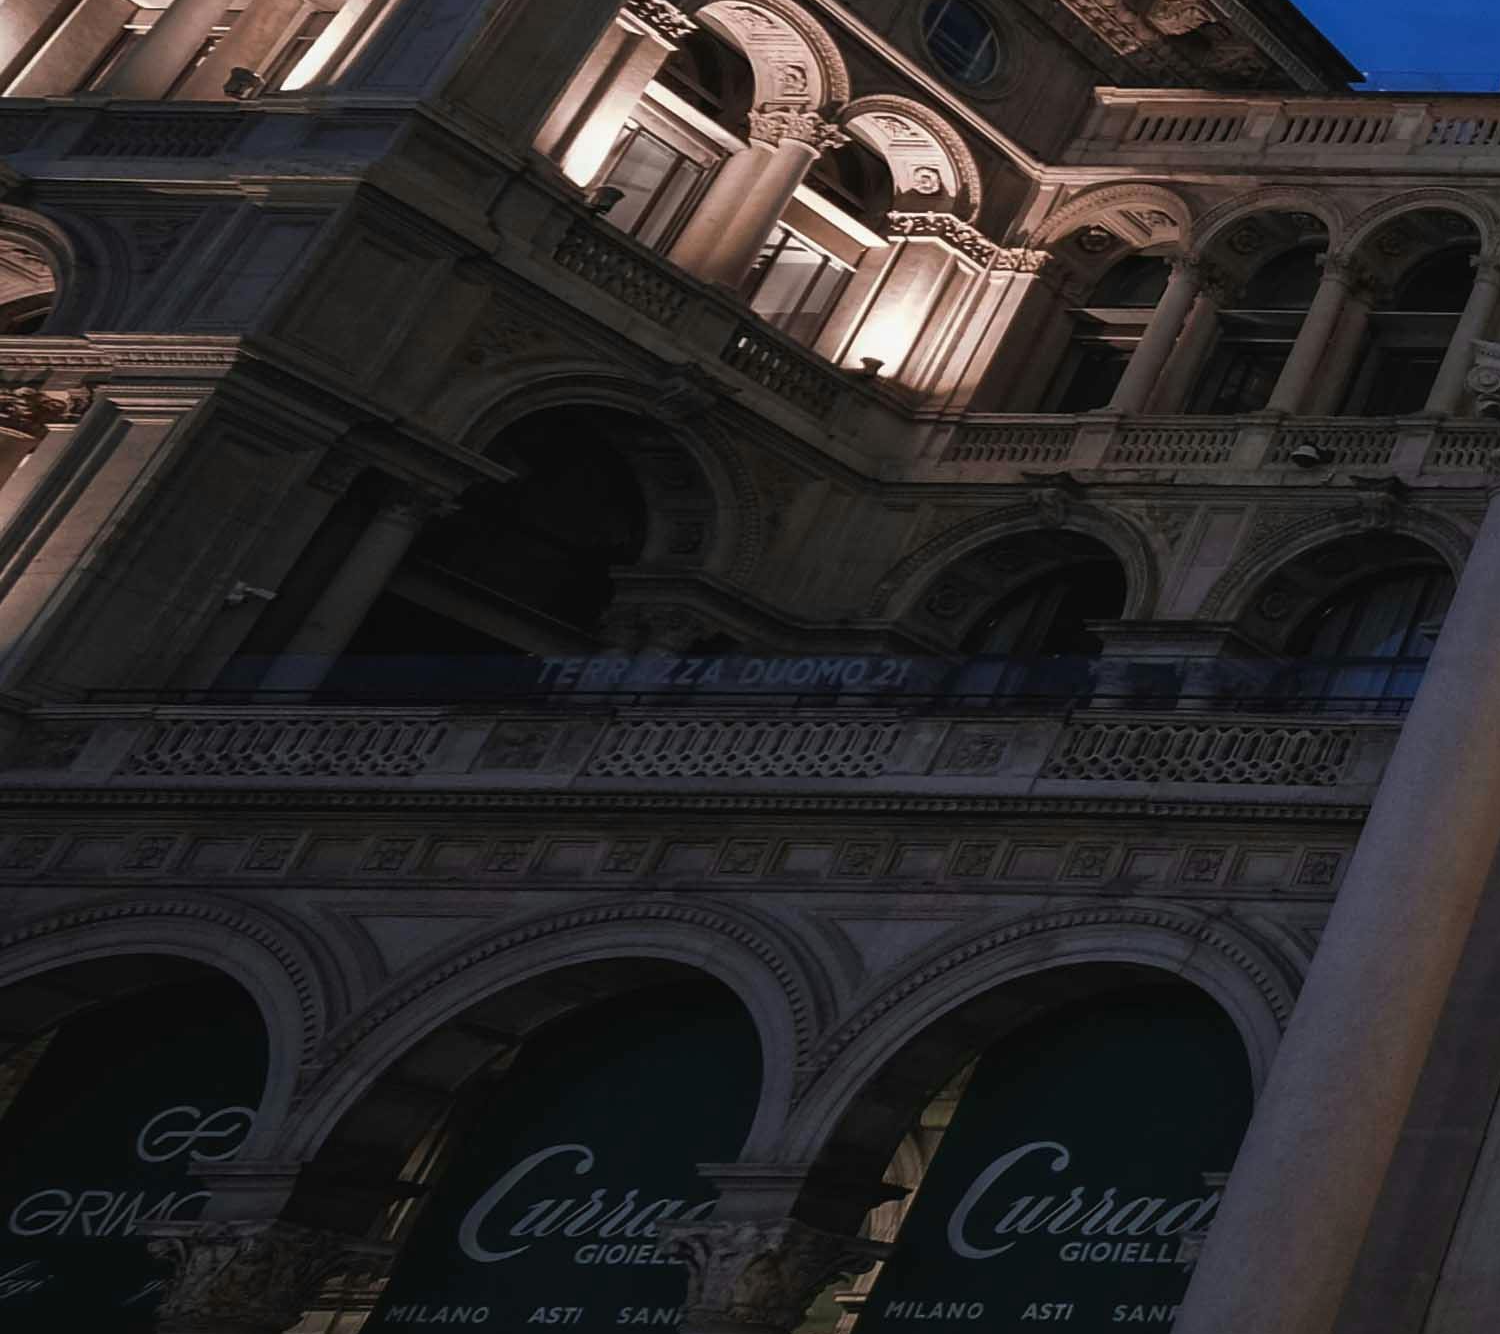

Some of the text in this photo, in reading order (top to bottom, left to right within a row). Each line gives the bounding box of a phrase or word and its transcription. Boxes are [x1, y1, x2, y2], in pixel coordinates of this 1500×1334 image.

[738, 658, 867, 684] DUOMO
[872, 658, 912, 685] 21
[384, 1305, 490, 1325] MILANO
[527, 1306, 584, 1325] ASTI
[883, 1300, 985, 1323] MILANO
[1020, 1302, 1075, 1323] ASTI
